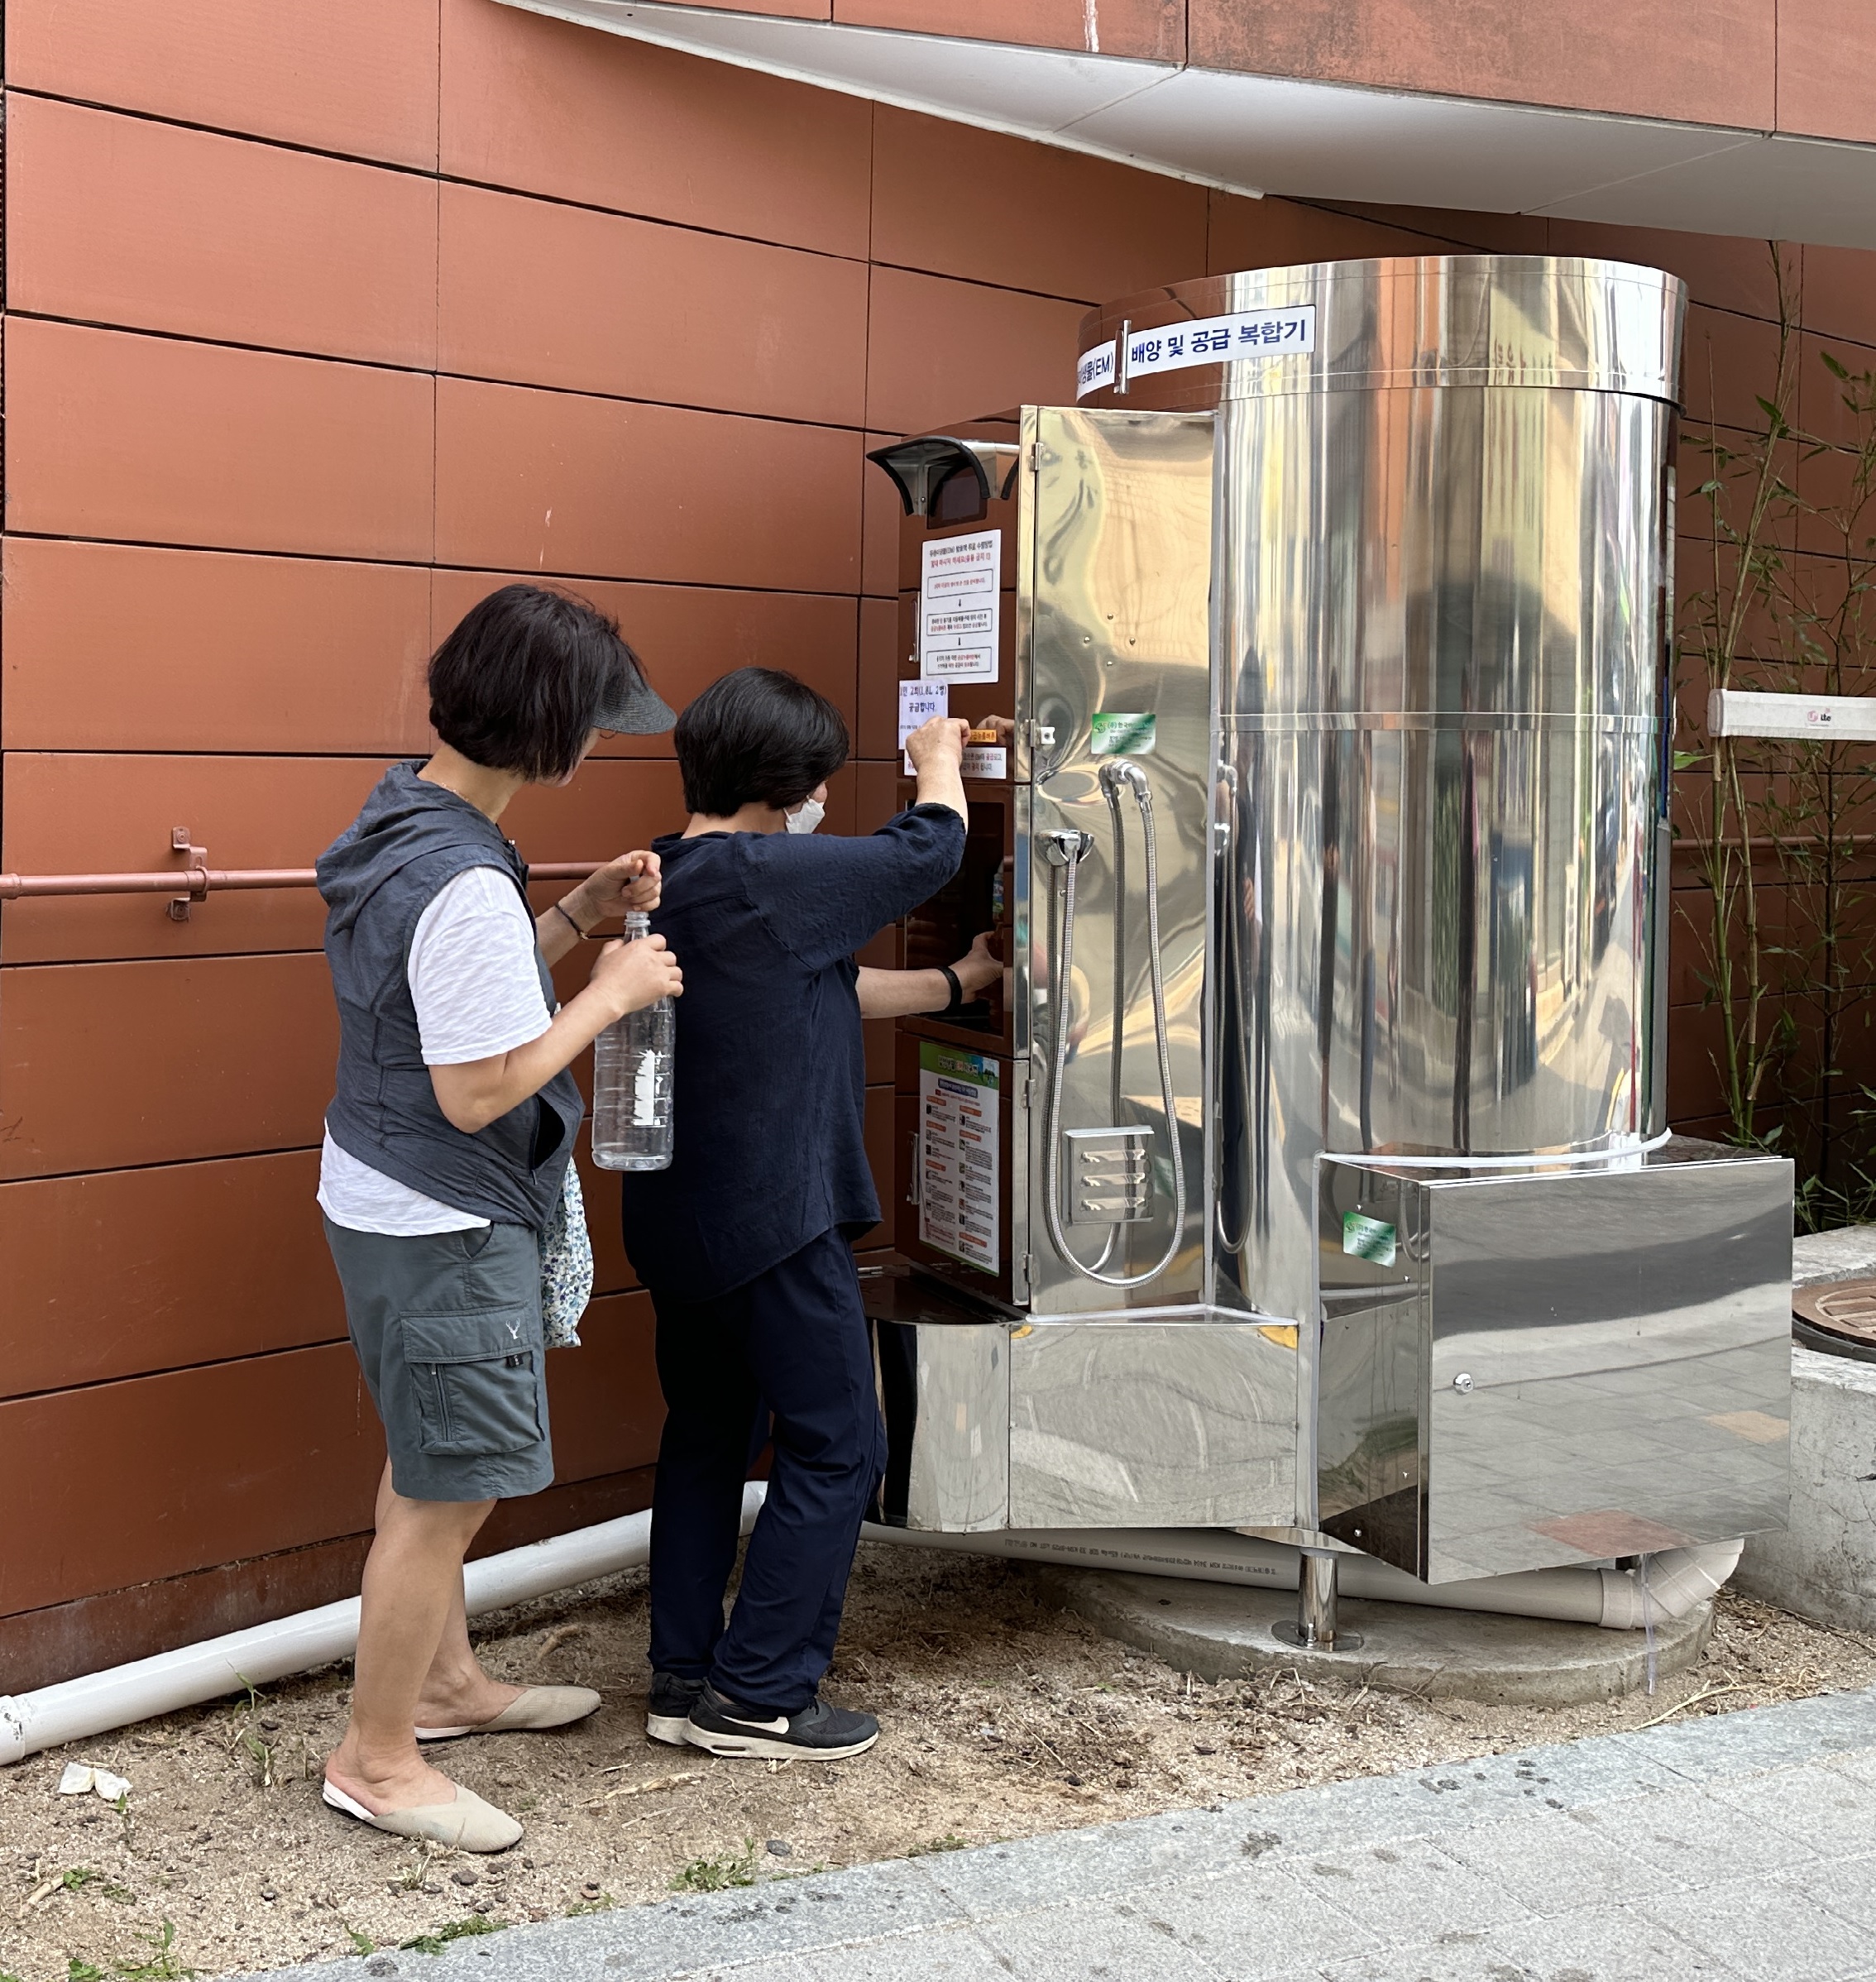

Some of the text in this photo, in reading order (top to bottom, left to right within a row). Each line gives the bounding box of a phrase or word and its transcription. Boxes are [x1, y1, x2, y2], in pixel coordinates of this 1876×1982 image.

[1131, 340, 1162, 363] 배양
[1168, 334, 1184, 357] 및
[1190, 328, 1232, 353] 공급
[1237, 319, 1306, 346] 복합기
